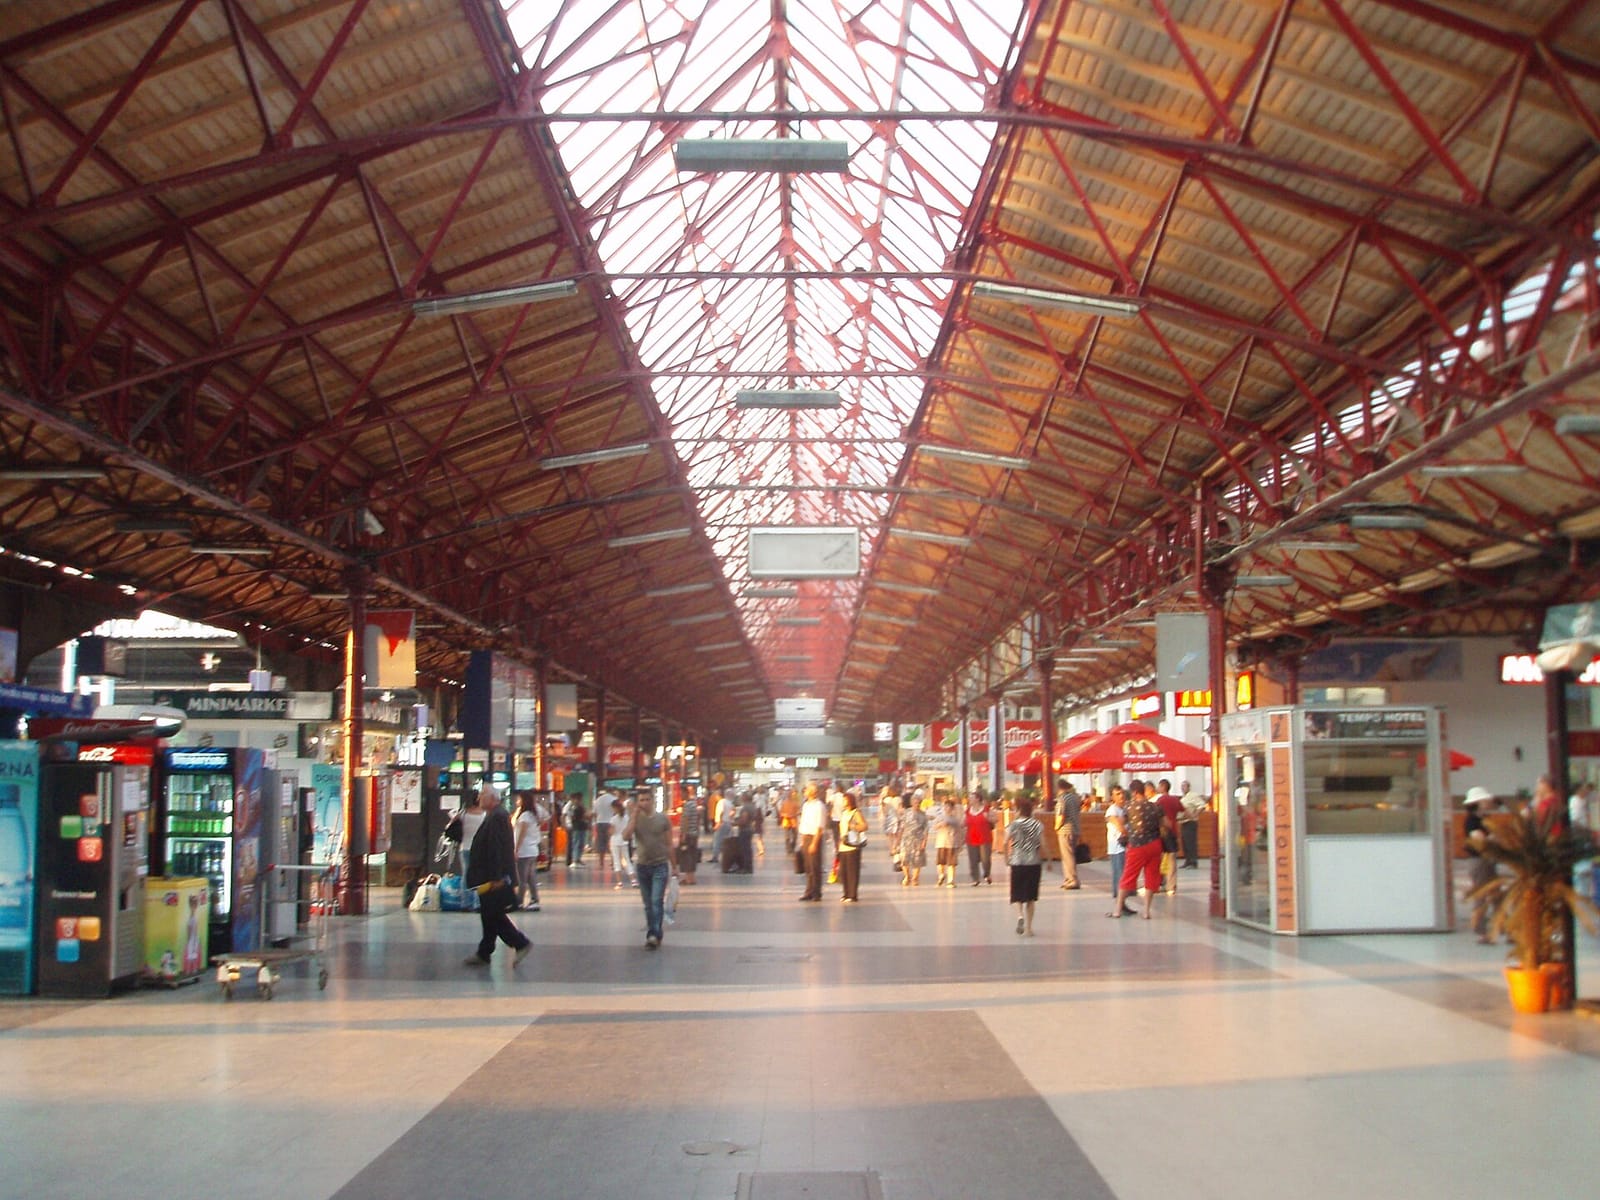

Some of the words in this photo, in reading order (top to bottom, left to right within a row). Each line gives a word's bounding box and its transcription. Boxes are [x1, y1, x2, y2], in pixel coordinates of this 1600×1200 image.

[187, 696, 298, 713] MINIMARKET
[1383, 712, 1427, 723] HOTEL
[0, 761, 35, 777] RNA
[754, 756, 786, 769] KFC
